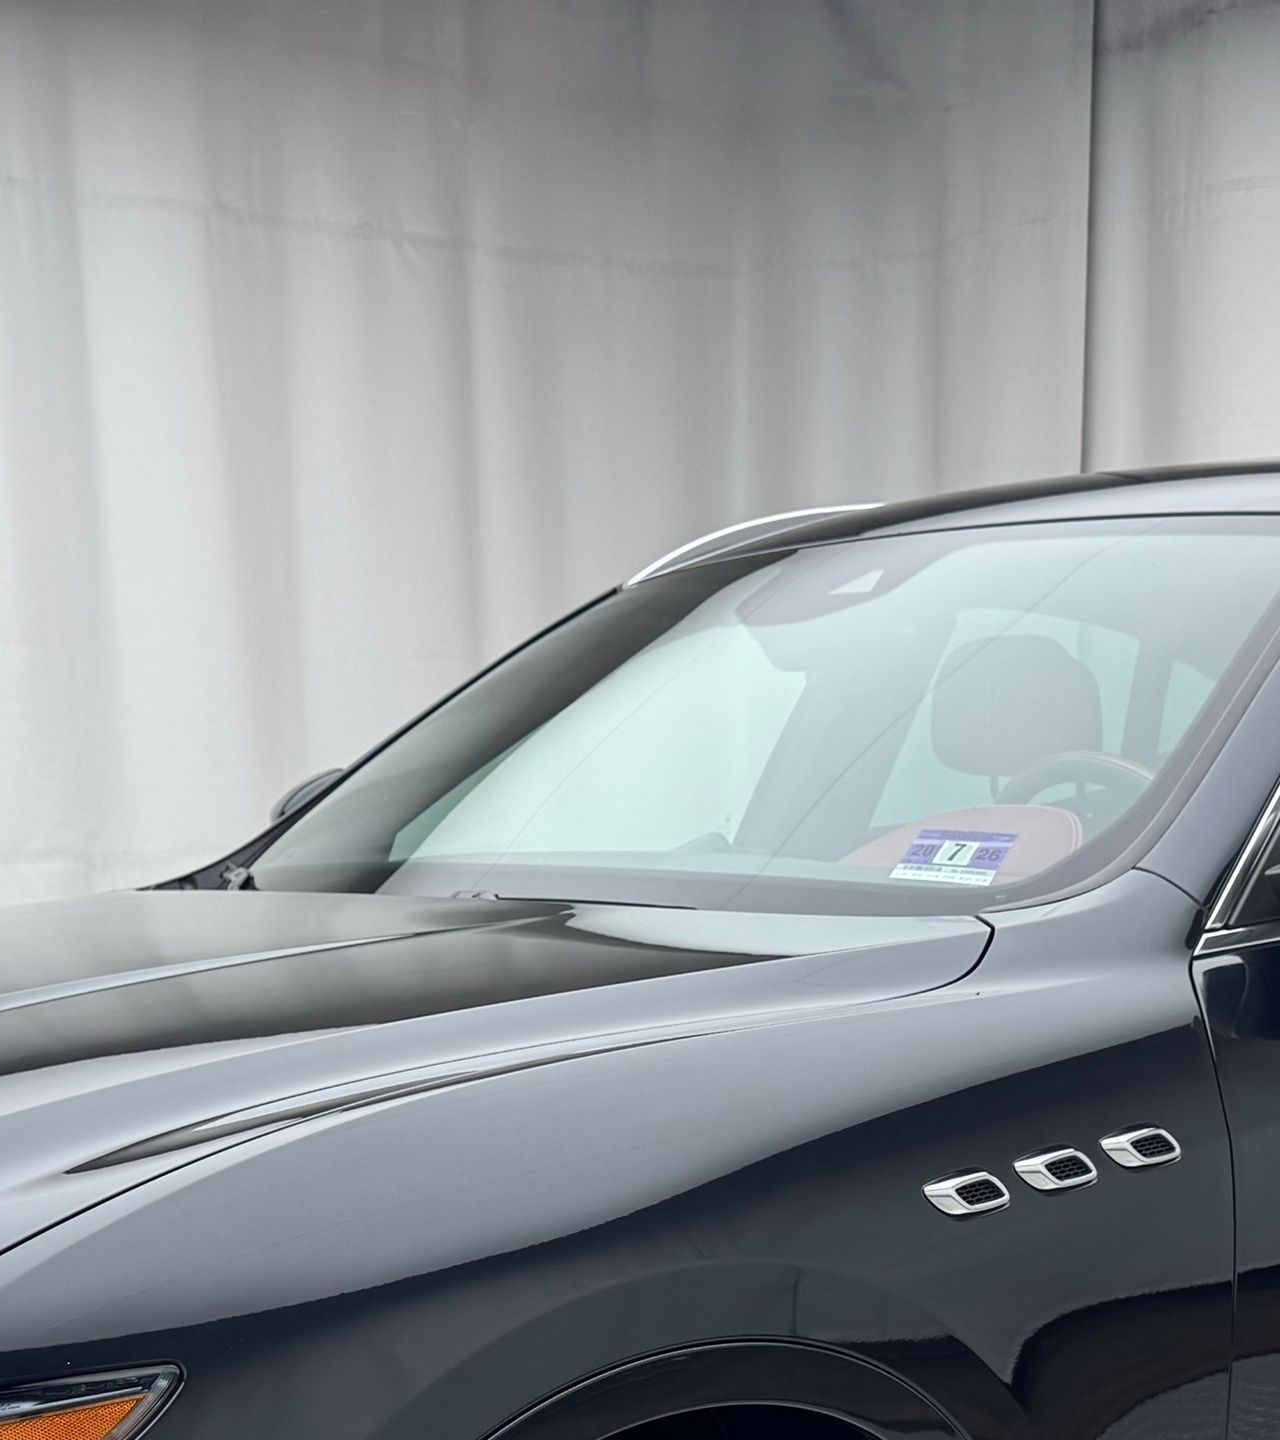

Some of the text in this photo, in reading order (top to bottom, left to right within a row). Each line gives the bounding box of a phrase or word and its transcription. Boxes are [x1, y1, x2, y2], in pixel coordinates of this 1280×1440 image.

[911, 842, 1002, 861] 20 7 26
